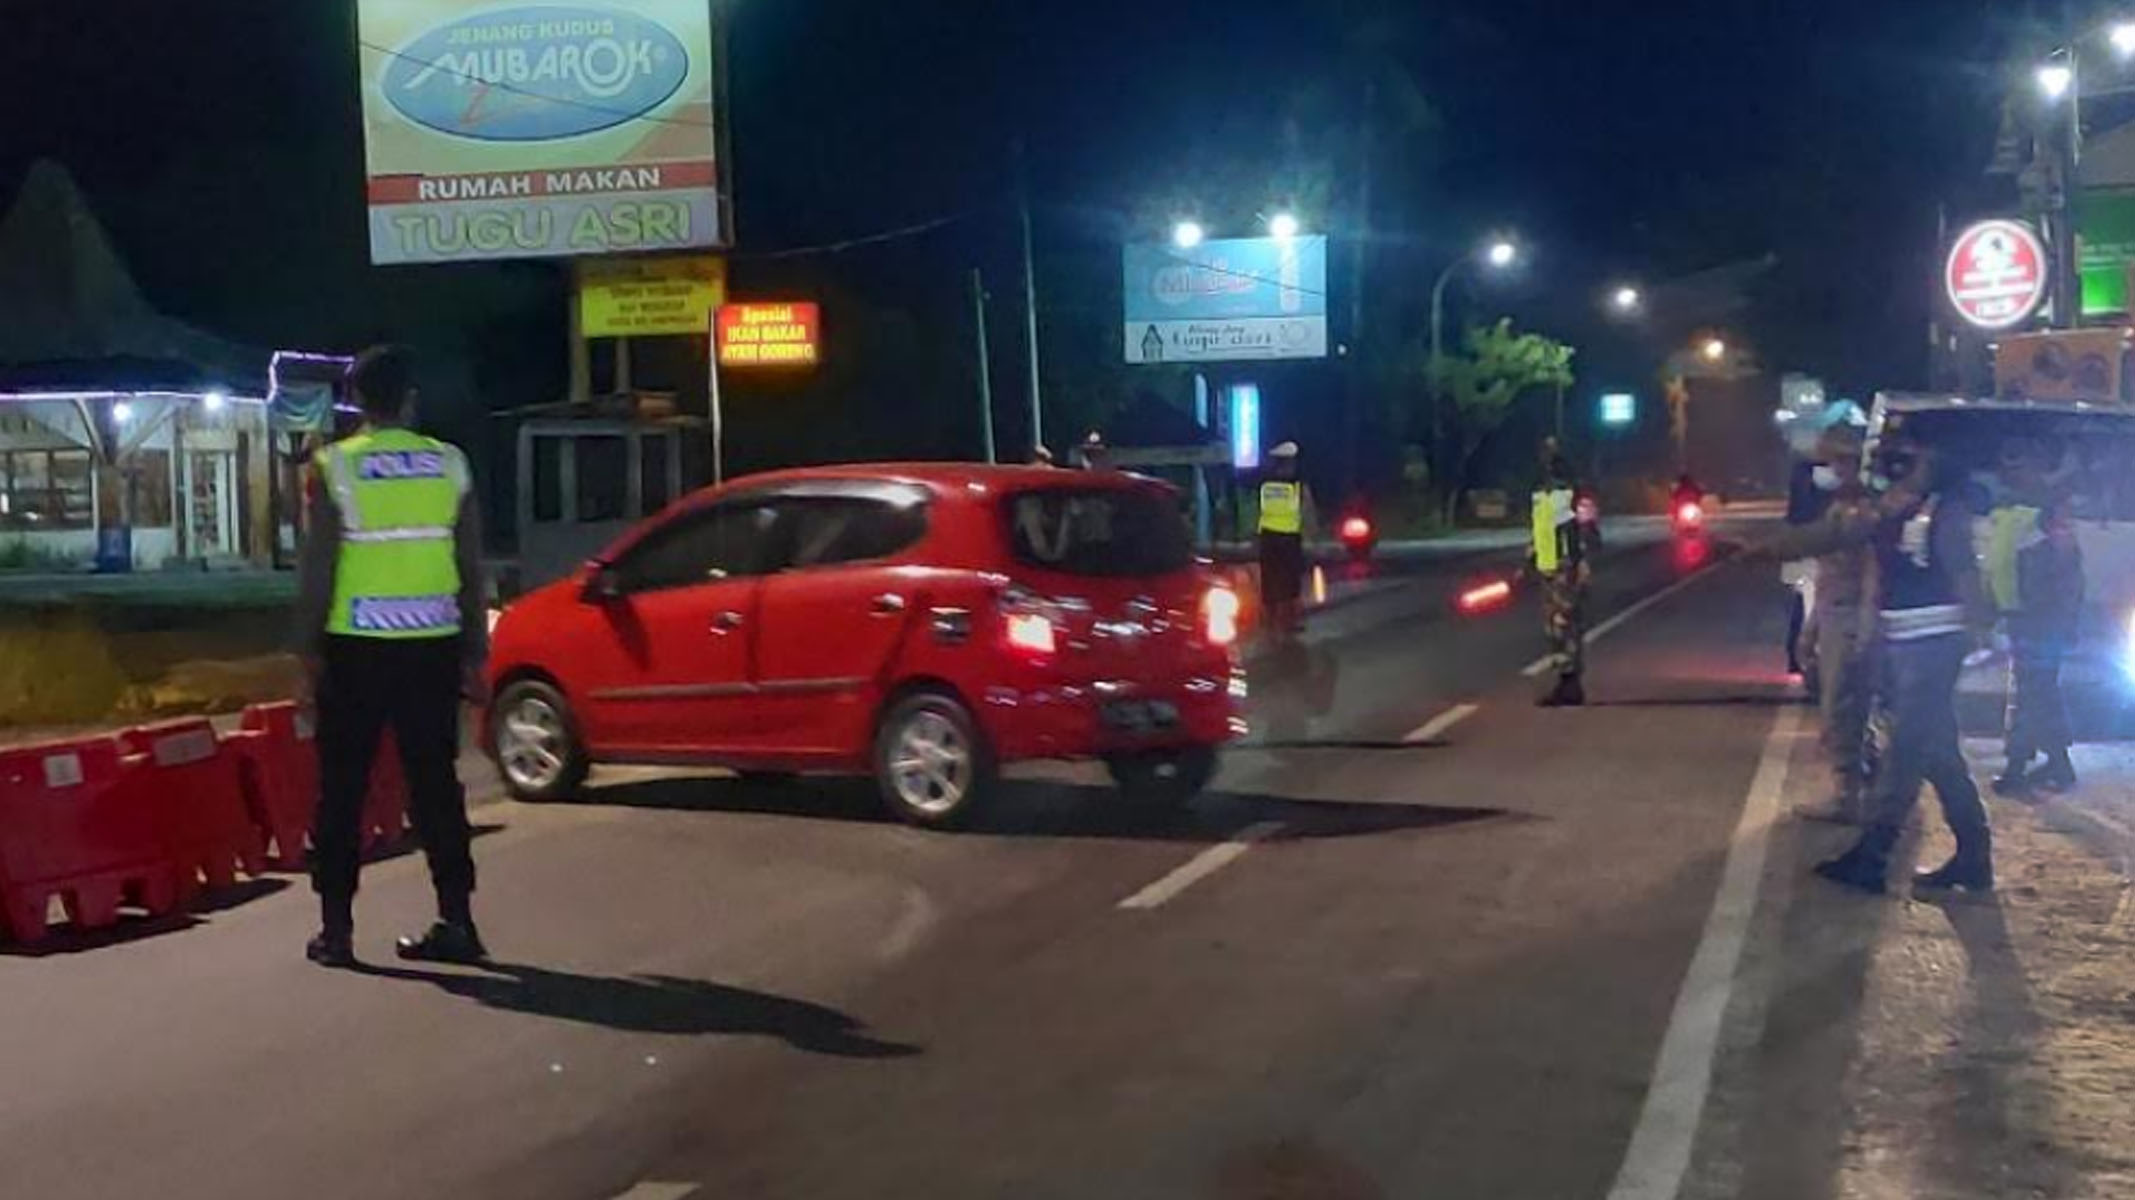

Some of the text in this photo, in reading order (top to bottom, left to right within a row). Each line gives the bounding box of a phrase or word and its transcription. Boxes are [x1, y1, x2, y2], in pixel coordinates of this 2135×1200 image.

[446, 19, 615, 45] JENANG KUDUS
[405, 37, 654, 97] MUBAROK
[418, 168, 661, 201] RUMAH MAKAN
[393, 201, 692, 254] TUGU ASRI
